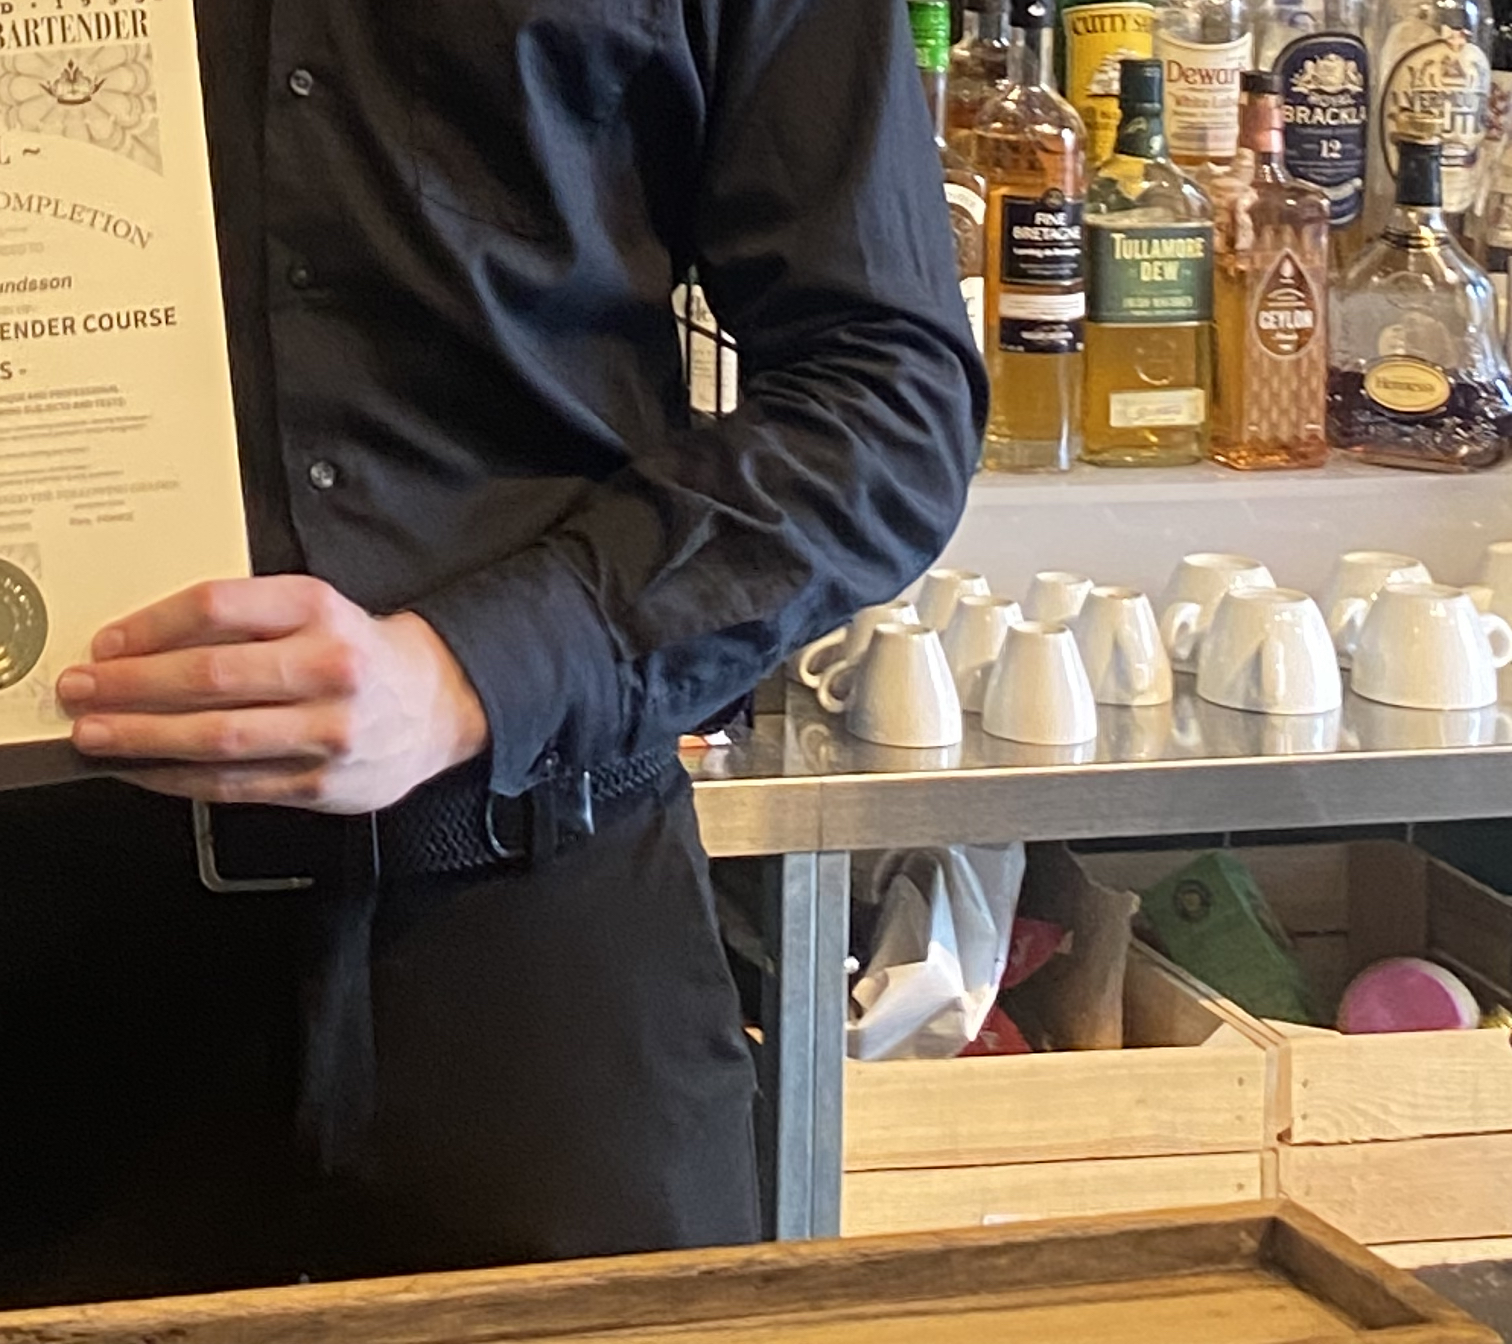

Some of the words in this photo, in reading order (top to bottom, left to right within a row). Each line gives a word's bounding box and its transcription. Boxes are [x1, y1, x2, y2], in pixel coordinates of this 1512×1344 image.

[1319, 138, 1343, 159] 12
[1110, 232, 1206, 259] TULLAMORE
[1139, 261, 1182, 282] DEW
[82, 306, 178, 334] COURSE
[1258, 309, 1315, 330] CEYLON
